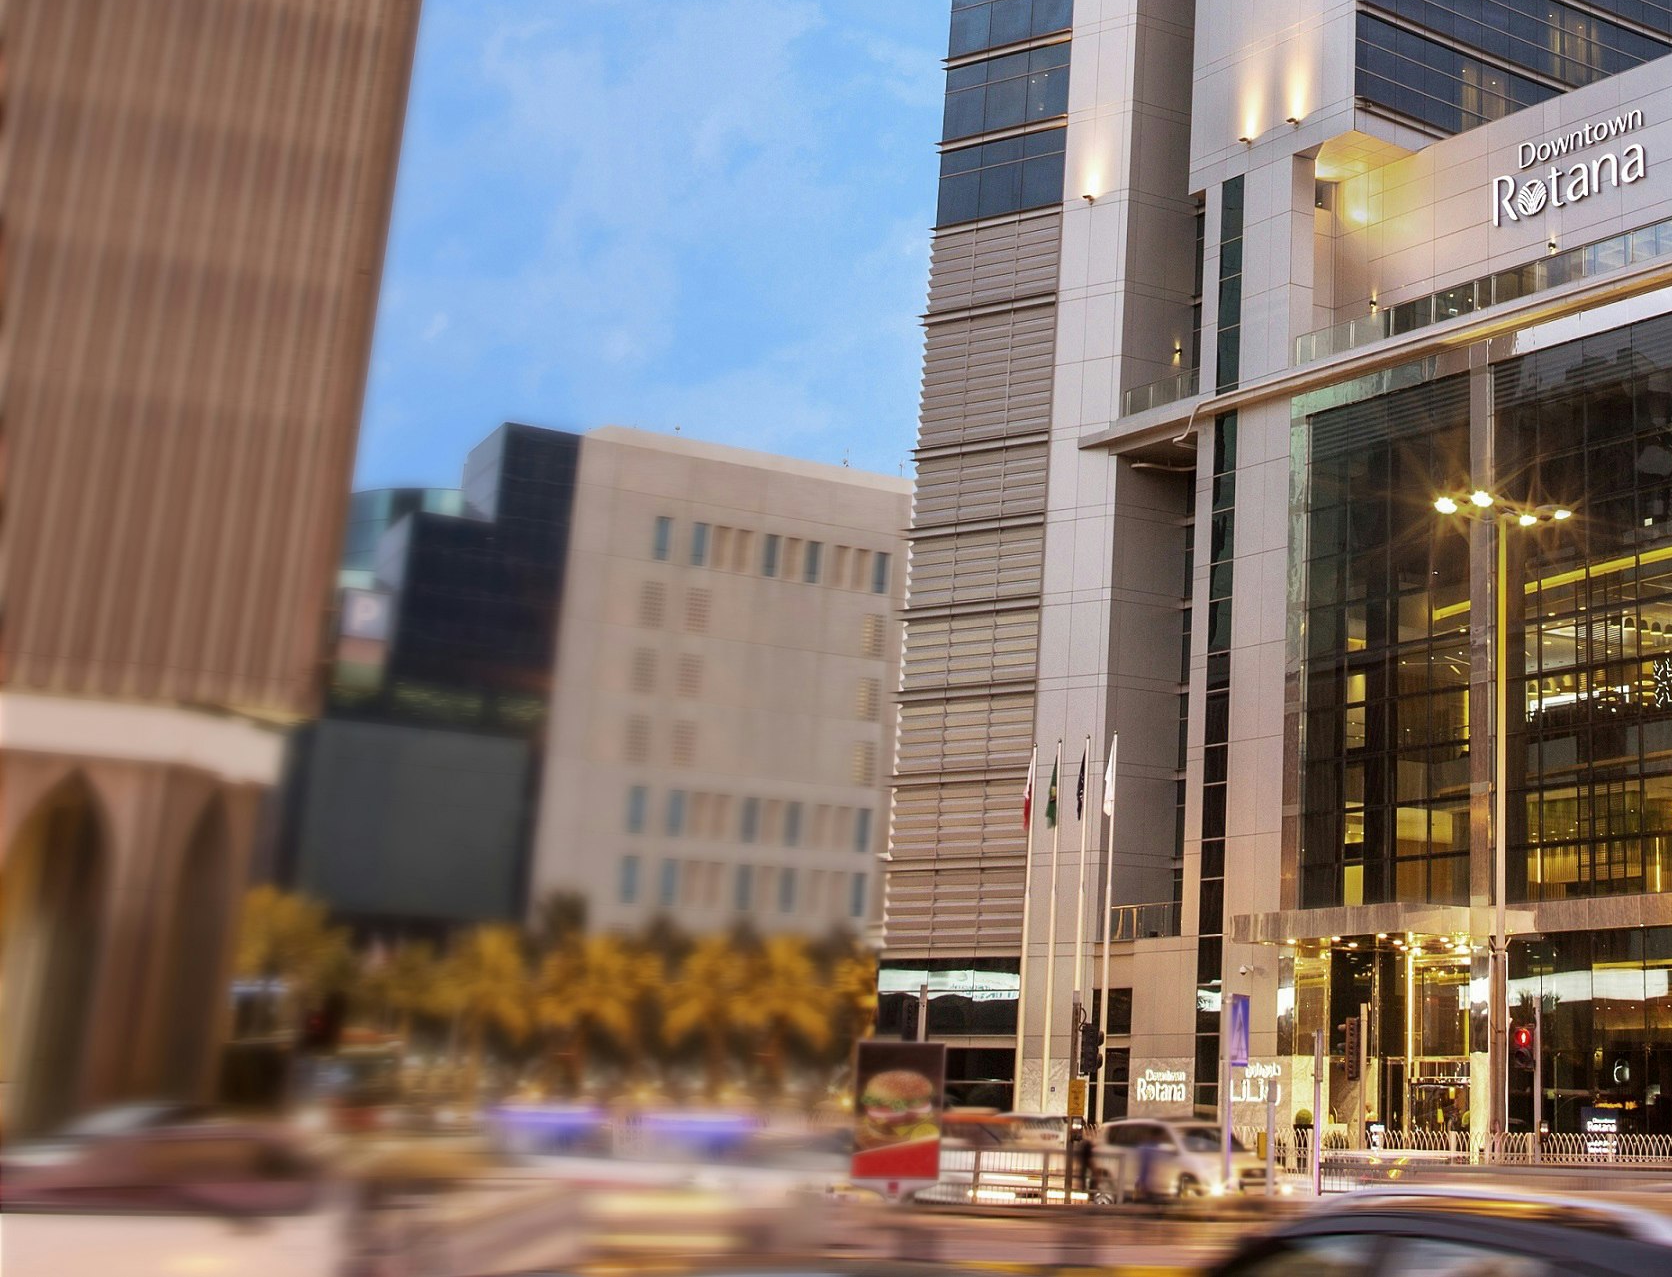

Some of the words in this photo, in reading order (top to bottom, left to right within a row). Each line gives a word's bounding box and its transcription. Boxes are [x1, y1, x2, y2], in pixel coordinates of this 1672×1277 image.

[1518, 109, 1643, 169] Downtown
[1493, 143, 1645, 227] Rotana
[1136, 1078, 1186, 1101] Rotana
